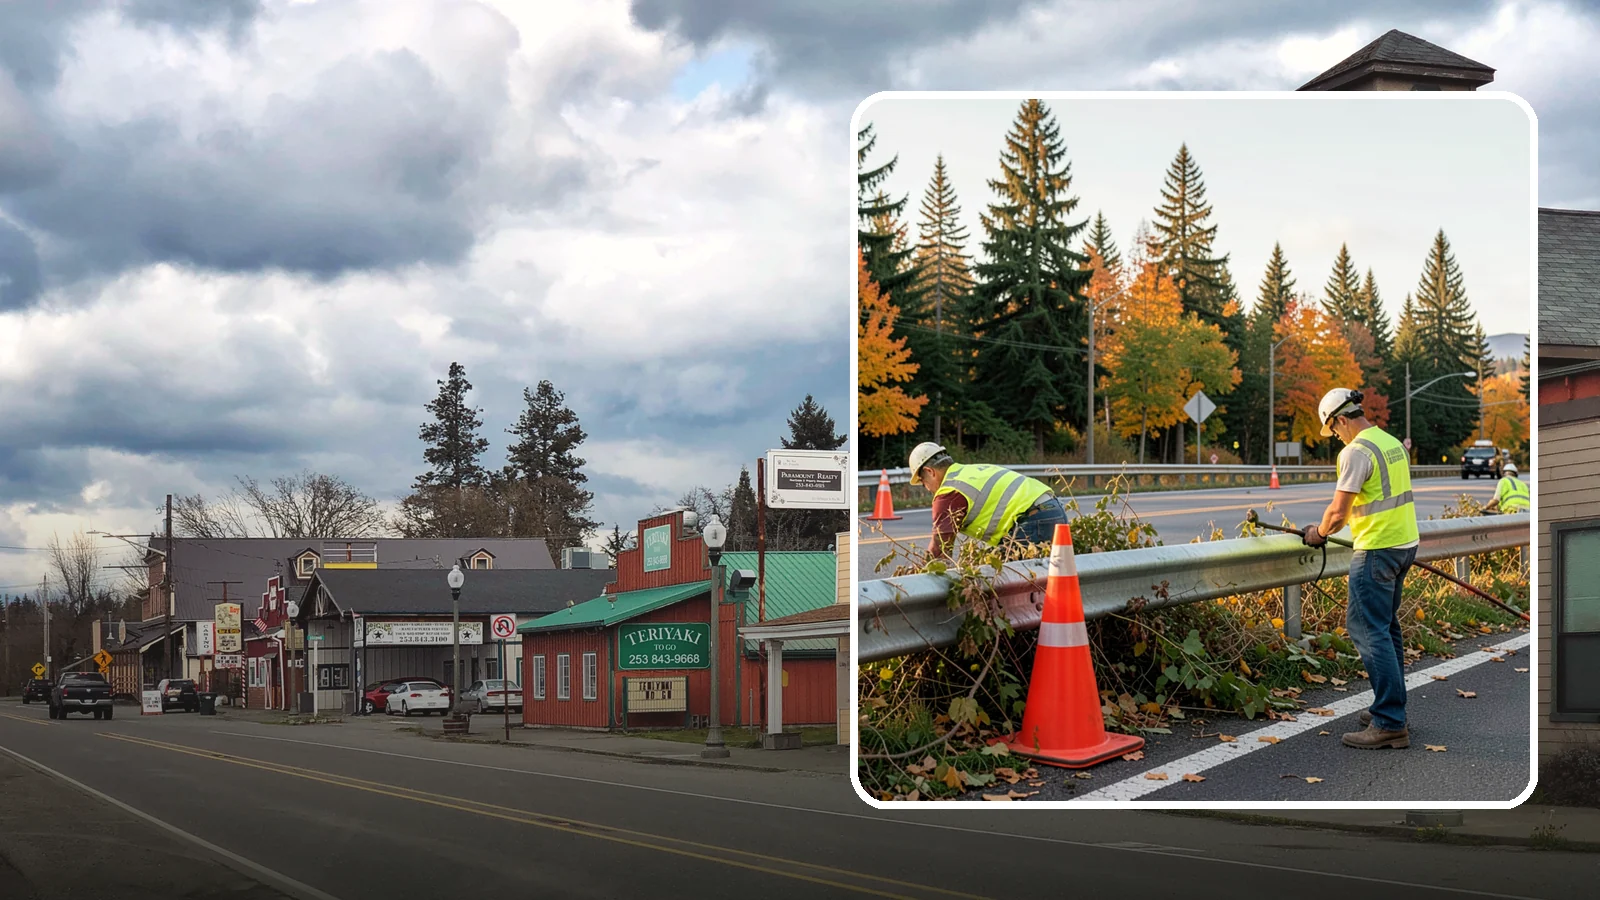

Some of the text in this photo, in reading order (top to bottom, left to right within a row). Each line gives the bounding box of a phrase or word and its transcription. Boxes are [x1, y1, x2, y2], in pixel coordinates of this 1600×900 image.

[624, 627, 702, 646] TERIYAKI
[629, 653, 700, 664] 253 843-9668
[639, 681, 672, 691] TERIYAKI
